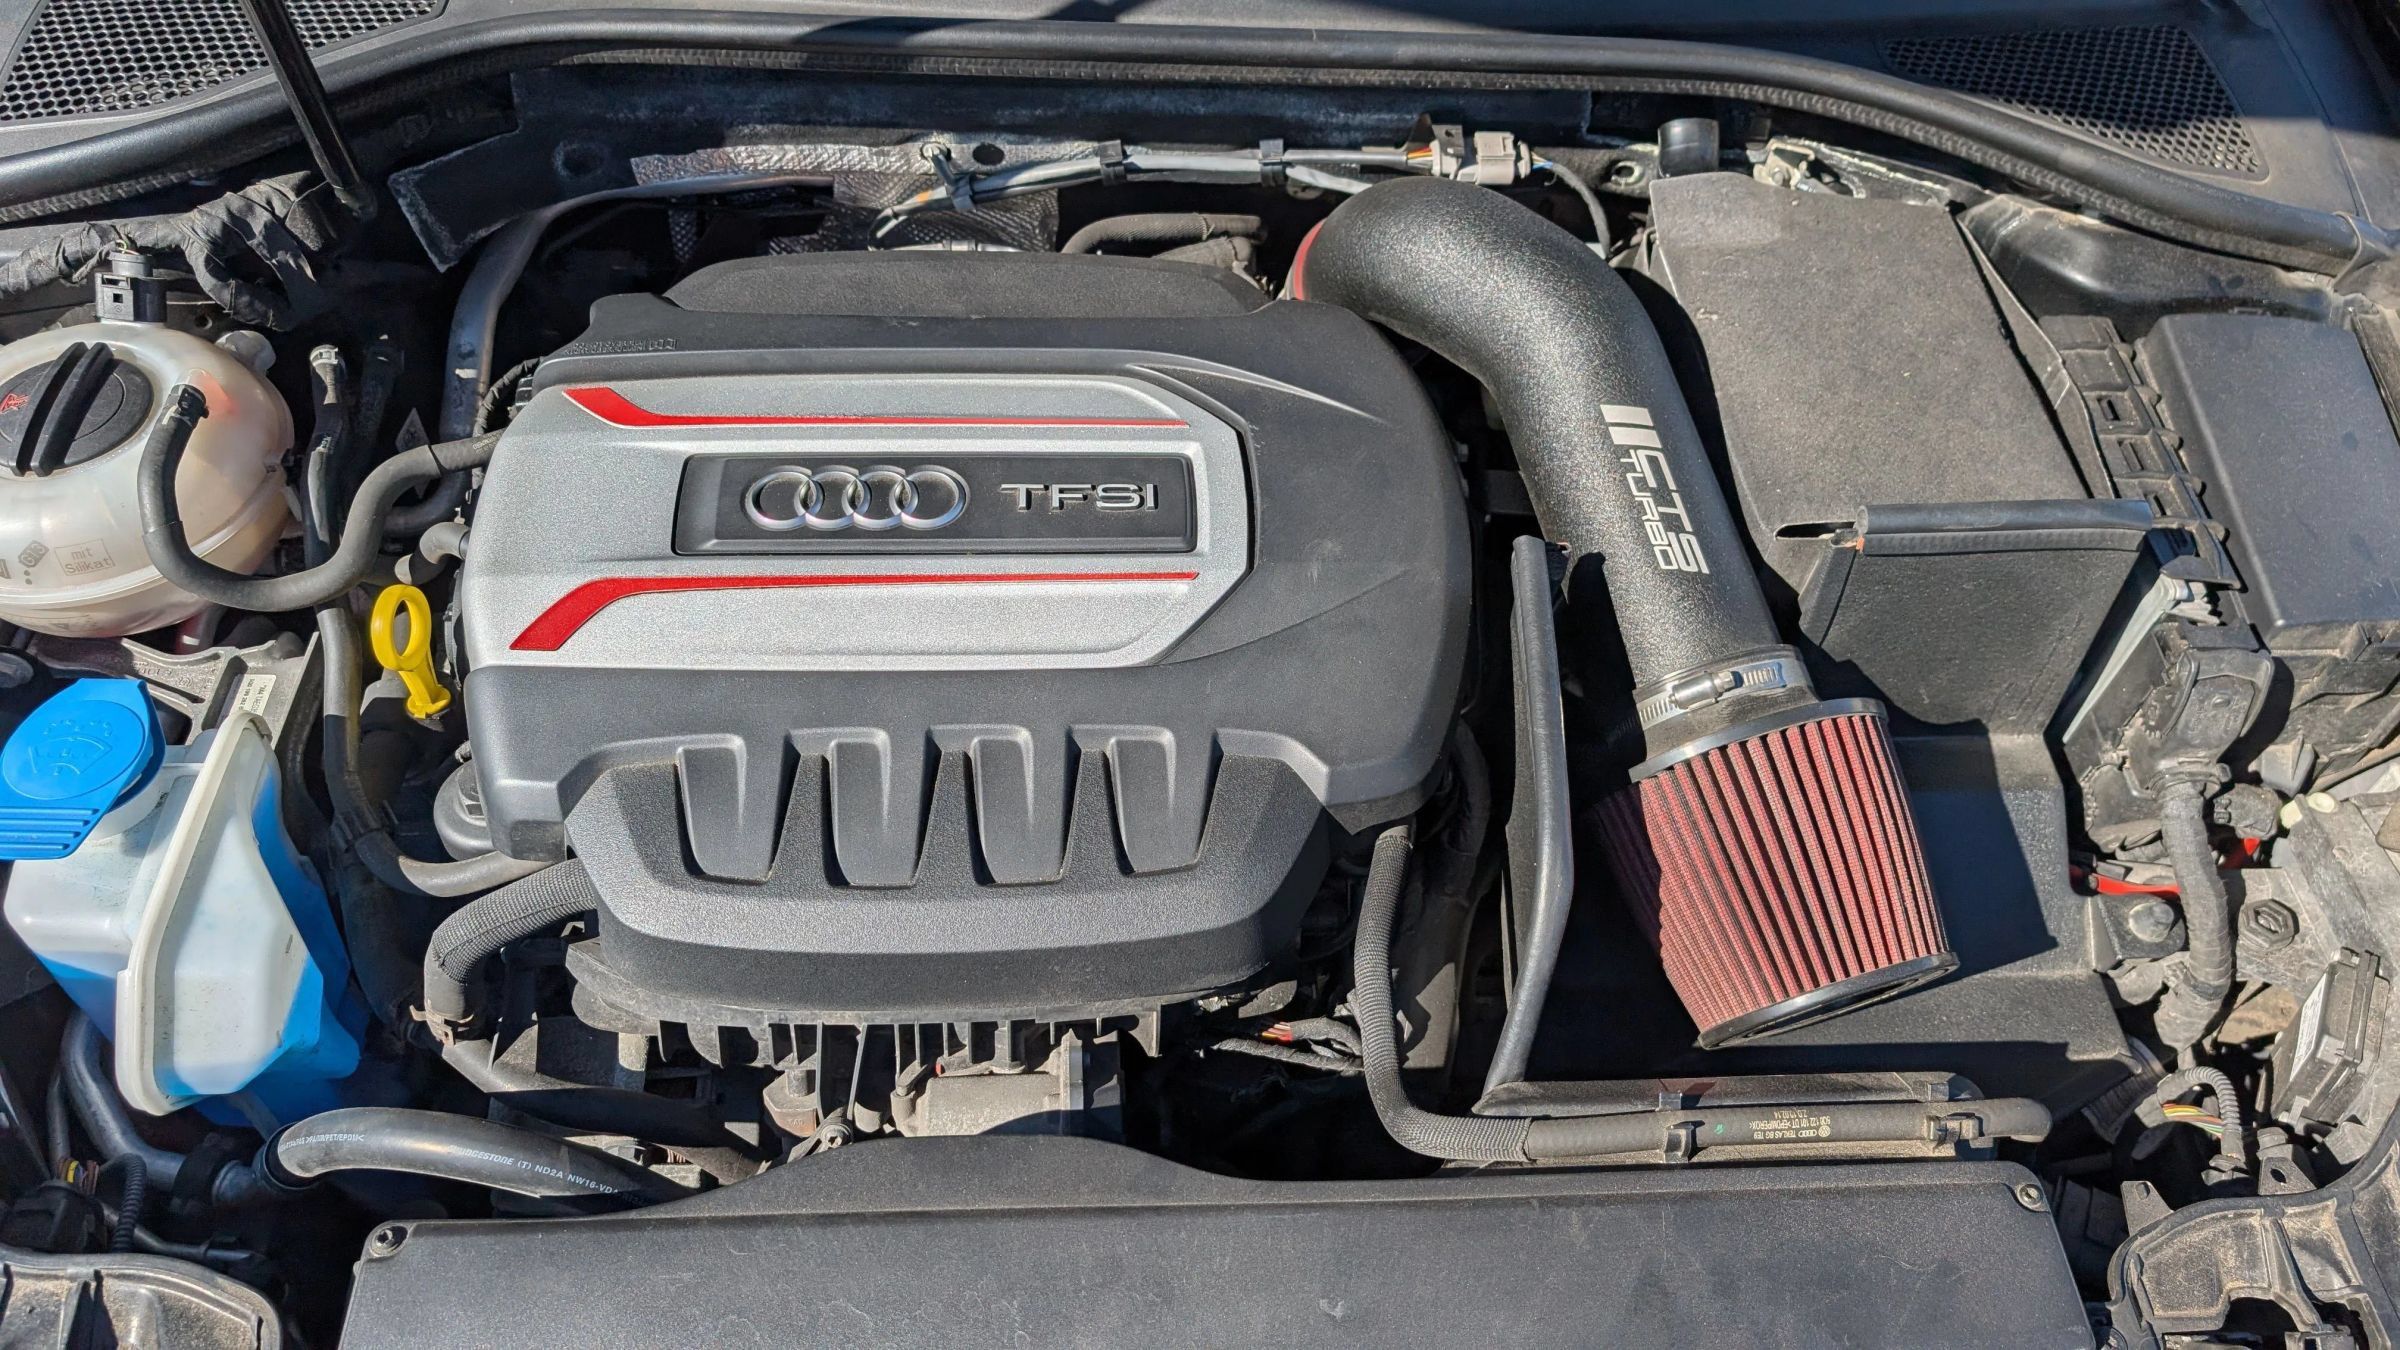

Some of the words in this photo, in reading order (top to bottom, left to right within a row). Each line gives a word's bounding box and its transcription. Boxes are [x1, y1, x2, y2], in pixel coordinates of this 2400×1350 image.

[1001, 482, 1159, 511] TFSI
[1620, 449, 1679, 570] TURBO
[1637, 449, 1710, 575] CTS
[64, 557, 115, 574] Silikat
[70, 547, 94, 560] mit
[517, 1159, 532, 1171] (T)
[534, 1164, 564, 1180] ND2A
